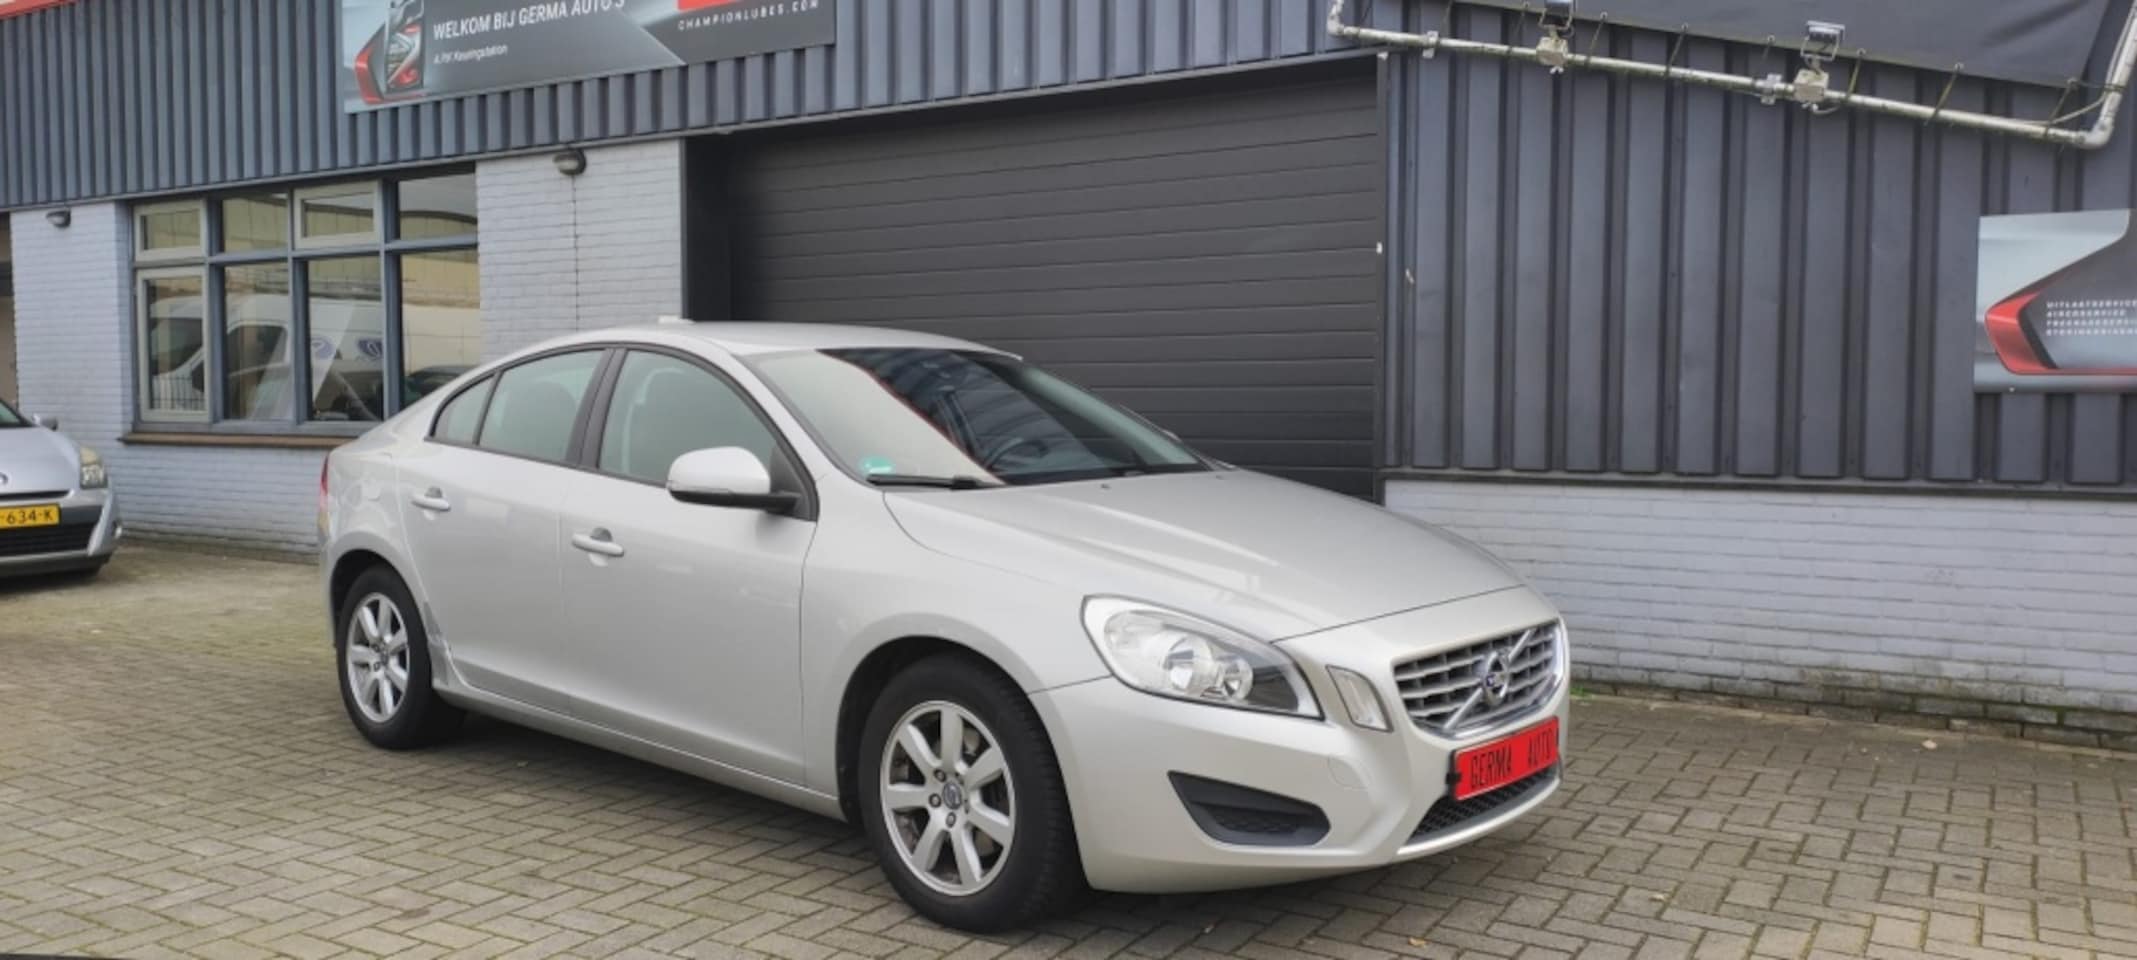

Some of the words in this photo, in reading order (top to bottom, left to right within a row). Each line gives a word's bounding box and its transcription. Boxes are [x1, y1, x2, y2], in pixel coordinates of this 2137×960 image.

[433, 14, 490, 40] WELKOM
[493, 10, 516, 31] BIJ
[519, 1, 568, 25] GERMA
[570, 0, 625, 16] AUTO
[677, 0, 819, 30] CHAMPIONLUBES.COM
[1472, 745, 1512, 789] GERMA
[1528, 728, 1556, 768] AUTO
